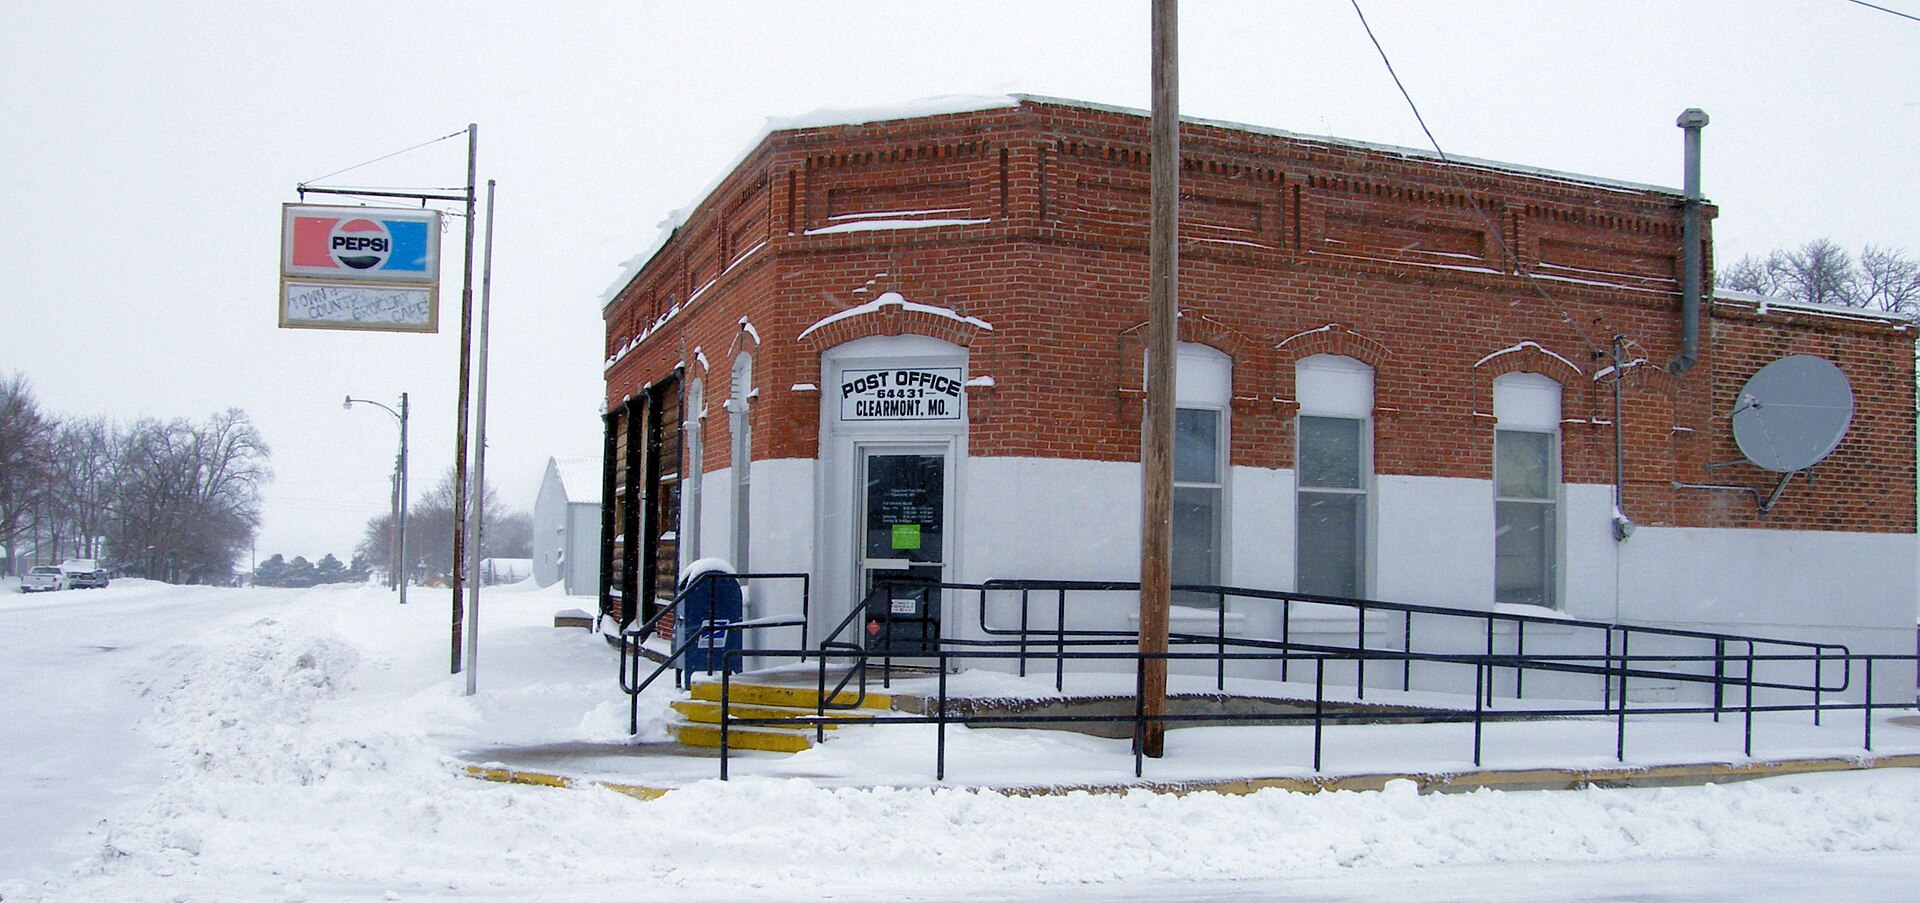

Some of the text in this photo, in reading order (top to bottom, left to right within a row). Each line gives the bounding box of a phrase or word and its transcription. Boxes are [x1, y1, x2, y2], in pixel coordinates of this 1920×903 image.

[332, 236, 389, 252] PEPSI
[289, 288, 327, 310] TOWN
[842, 371, 961, 399] POST OFFICE
[928, 399, 949, 416] MO.
